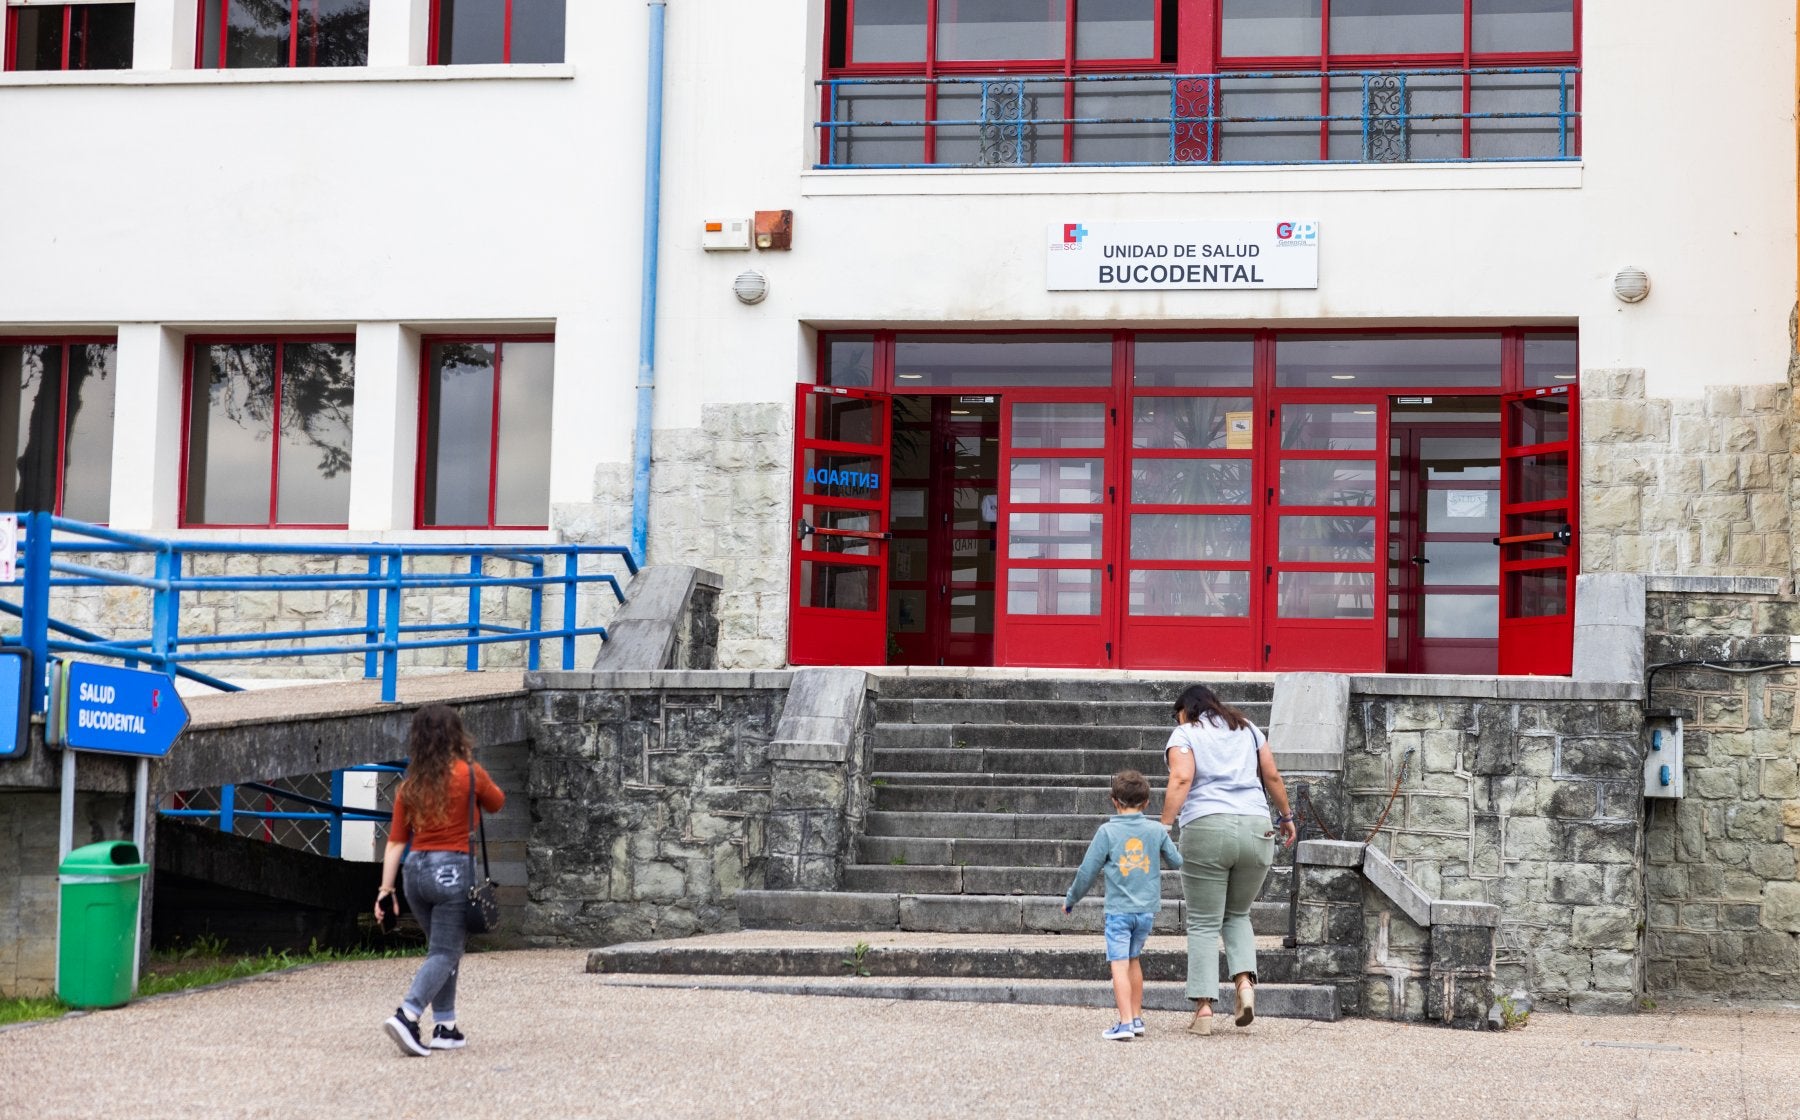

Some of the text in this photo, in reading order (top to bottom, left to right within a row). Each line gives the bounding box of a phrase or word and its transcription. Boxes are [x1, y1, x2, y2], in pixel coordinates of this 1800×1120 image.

[1063, 242, 1082, 251] SCS
[1103, 244, 1260, 258] UNIDAD DE SALUD
[1099, 264, 1264, 284] BUCODENTAL
[79, 682, 116, 704] SALUD
[78, 708, 146, 734] BUCODENTAL
